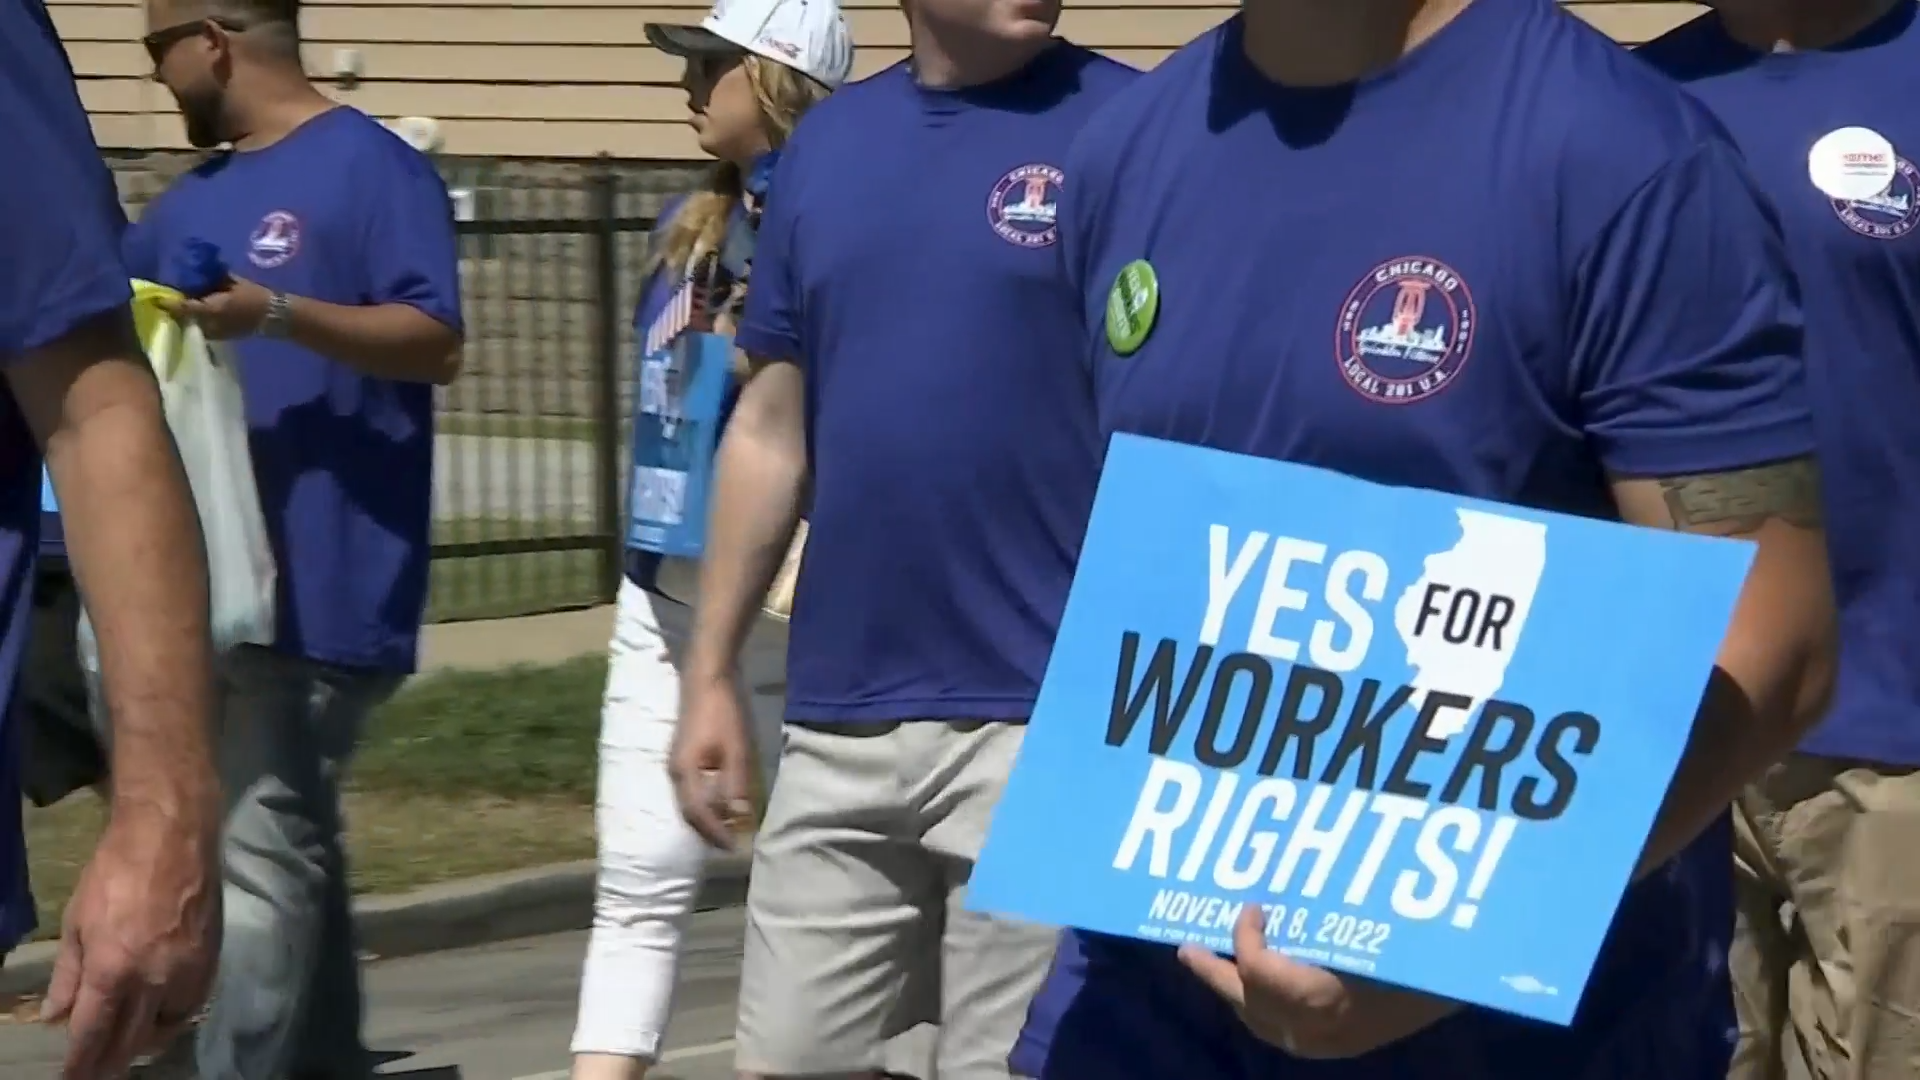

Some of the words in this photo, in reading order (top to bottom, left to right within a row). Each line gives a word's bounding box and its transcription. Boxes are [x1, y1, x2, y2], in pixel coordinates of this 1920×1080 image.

[1375, 261, 1459, 292] CHICAGO
[1344, 356, 1381, 395] LOCAL
[1200, 524, 1390, 672] YES
[1413, 582, 1516, 652] FOR
[1104, 630, 1602, 821] WORKERS
[1112, 756, 1518, 930] RIGHTS!
[1287, 906, 1309, 945] 8,
[1314, 911, 1392, 955] 2022
